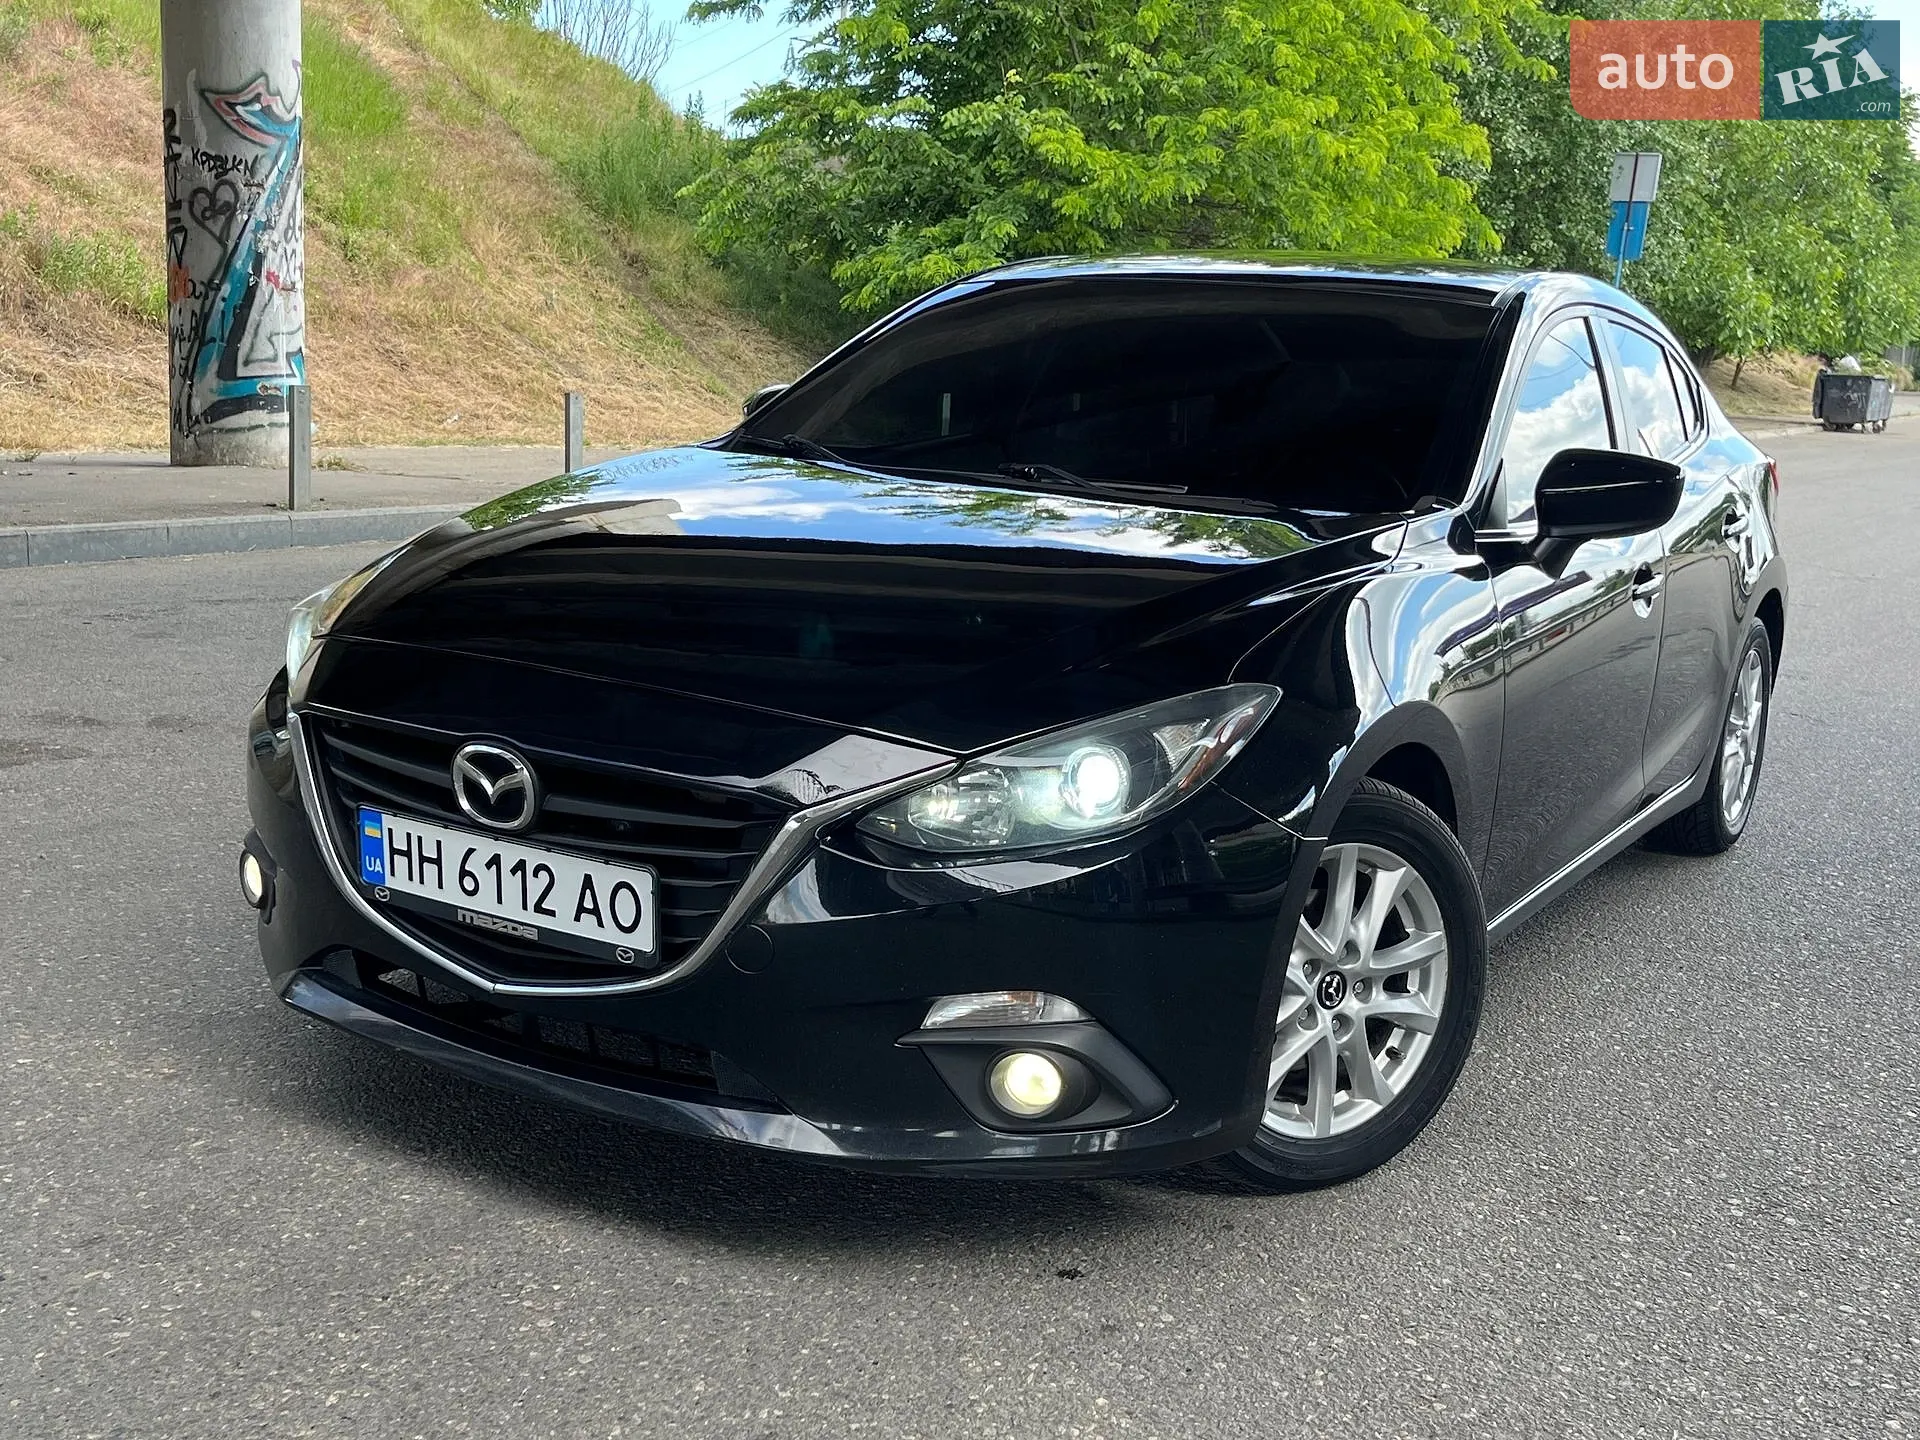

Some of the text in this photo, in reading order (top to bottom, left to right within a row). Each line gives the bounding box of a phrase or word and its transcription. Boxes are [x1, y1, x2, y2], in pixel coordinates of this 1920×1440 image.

[365, 856, 383, 874] UA
[387, 827, 643, 935] HH 6112 AO
